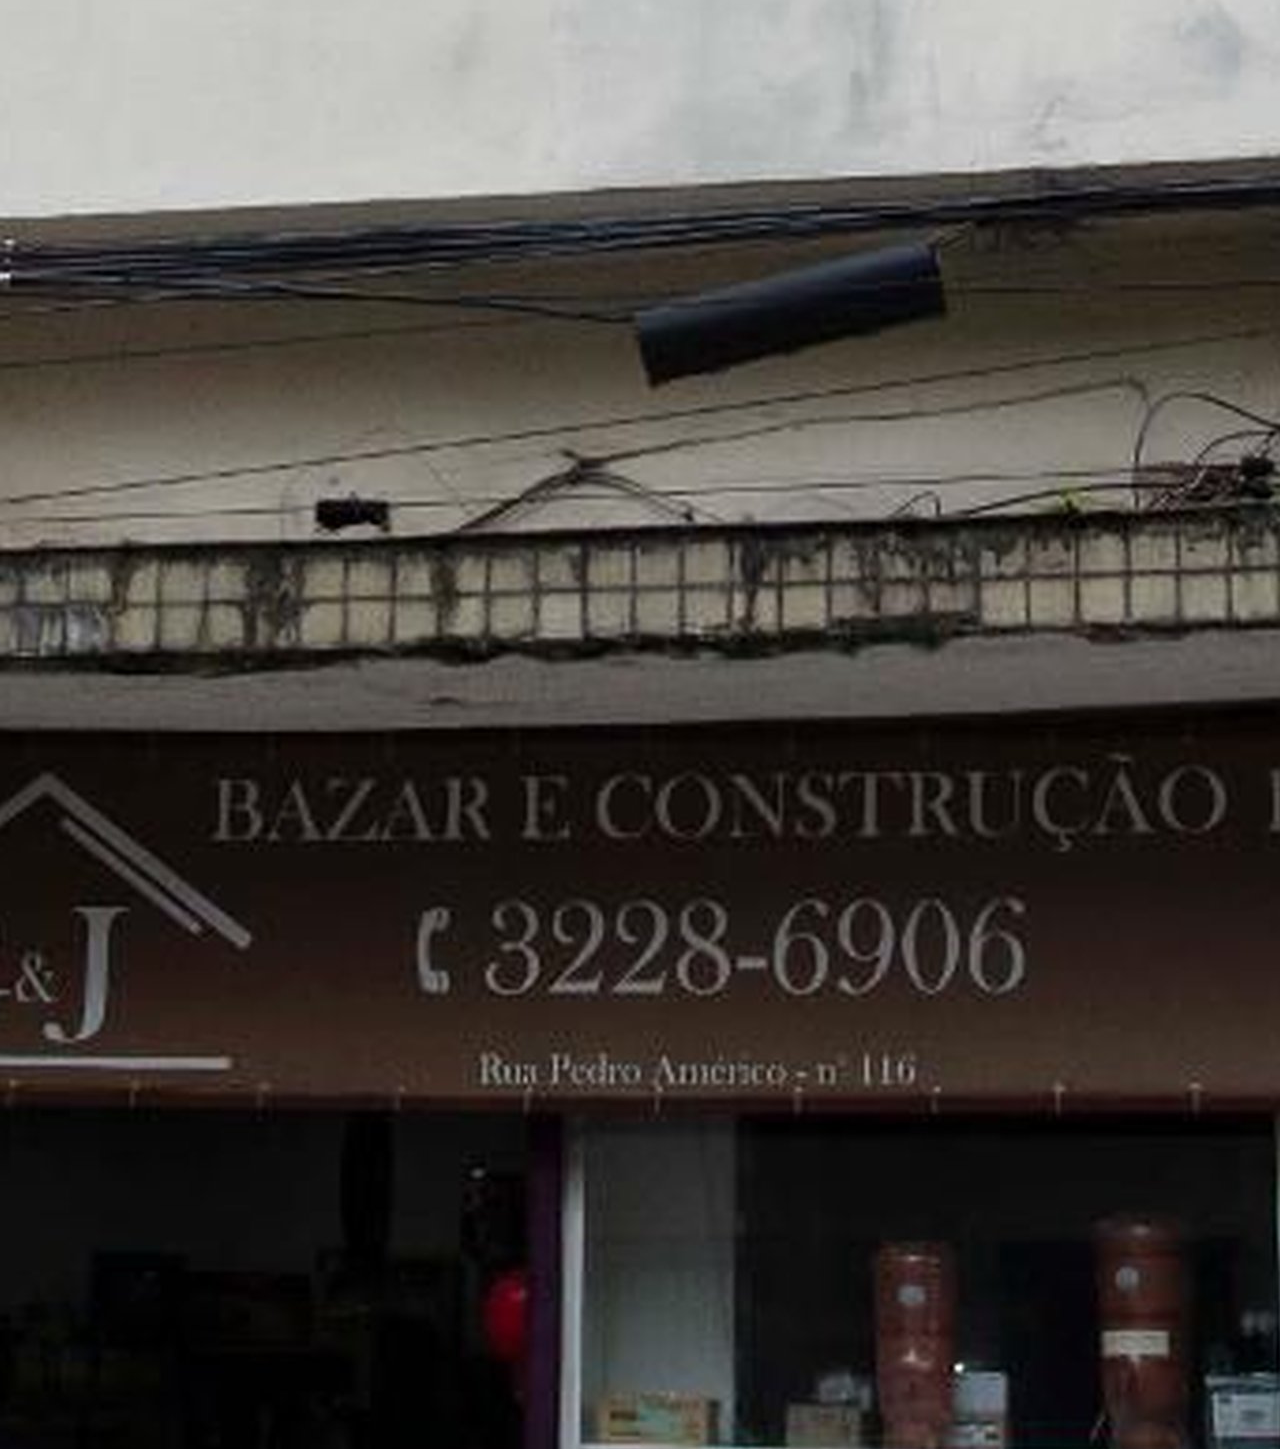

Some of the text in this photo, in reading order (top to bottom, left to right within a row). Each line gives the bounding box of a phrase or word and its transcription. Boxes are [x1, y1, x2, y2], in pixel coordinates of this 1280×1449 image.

[212, 774, 492, 843] BAZAR
[521, 774, 571, 841] E
[596, 754, 1228, 852] CONSTRUÇÃO
[484, 898, 1028, 997] 3228-6906
[479, 1052, 537, 1087] Rua
[550, 1052, 642, 1086] Pedro
[652, 1052, 787, 1086] Américo
[861, 1052, 917, 1085] 116
